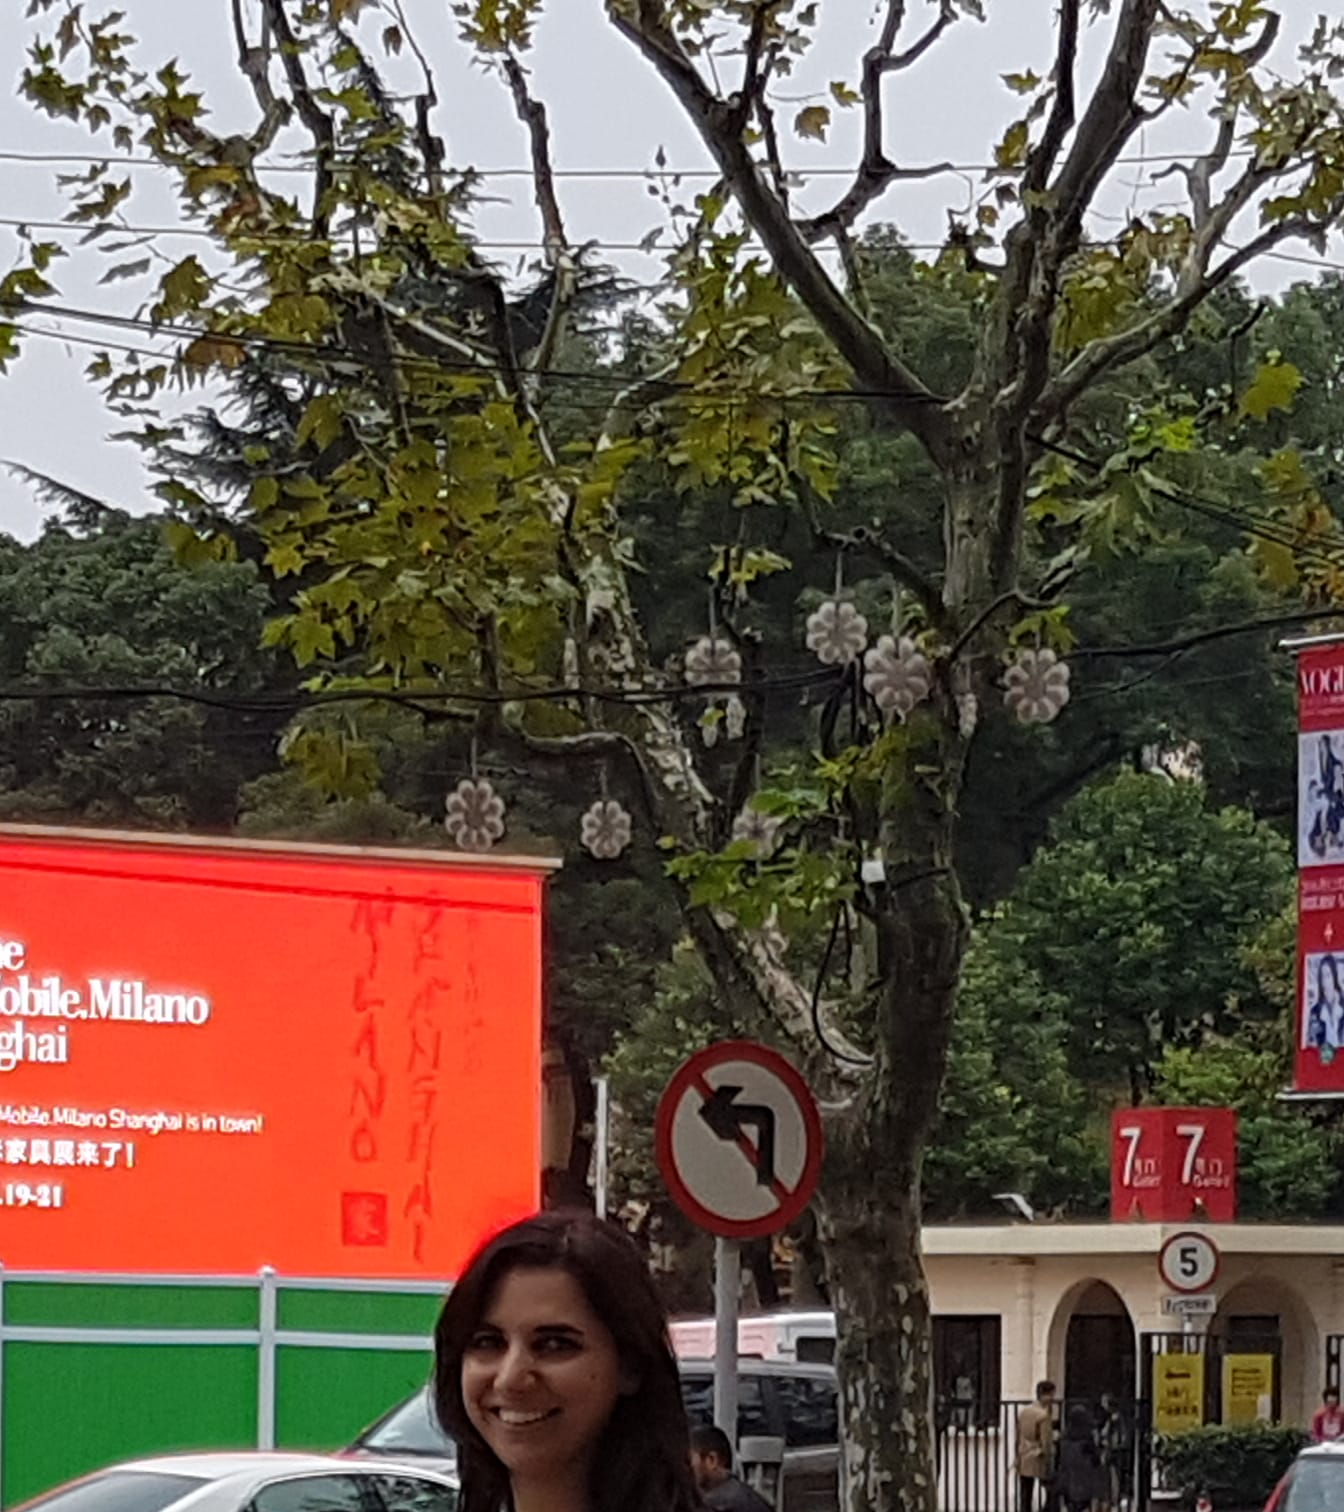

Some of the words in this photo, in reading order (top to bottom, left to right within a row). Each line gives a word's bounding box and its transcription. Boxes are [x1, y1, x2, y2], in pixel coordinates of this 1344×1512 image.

[109, 1108, 182, 1135] Shanghai
[186, 1114, 199, 1131] is
[202, 1113, 216, 1131] in
[219, 1113, 264, 1133] town!
[1120, 1126, 1141, 1187] 7
[1176, 1124, 1205, 1184] 7
[1180, 1247, 1199, 1277] 5
